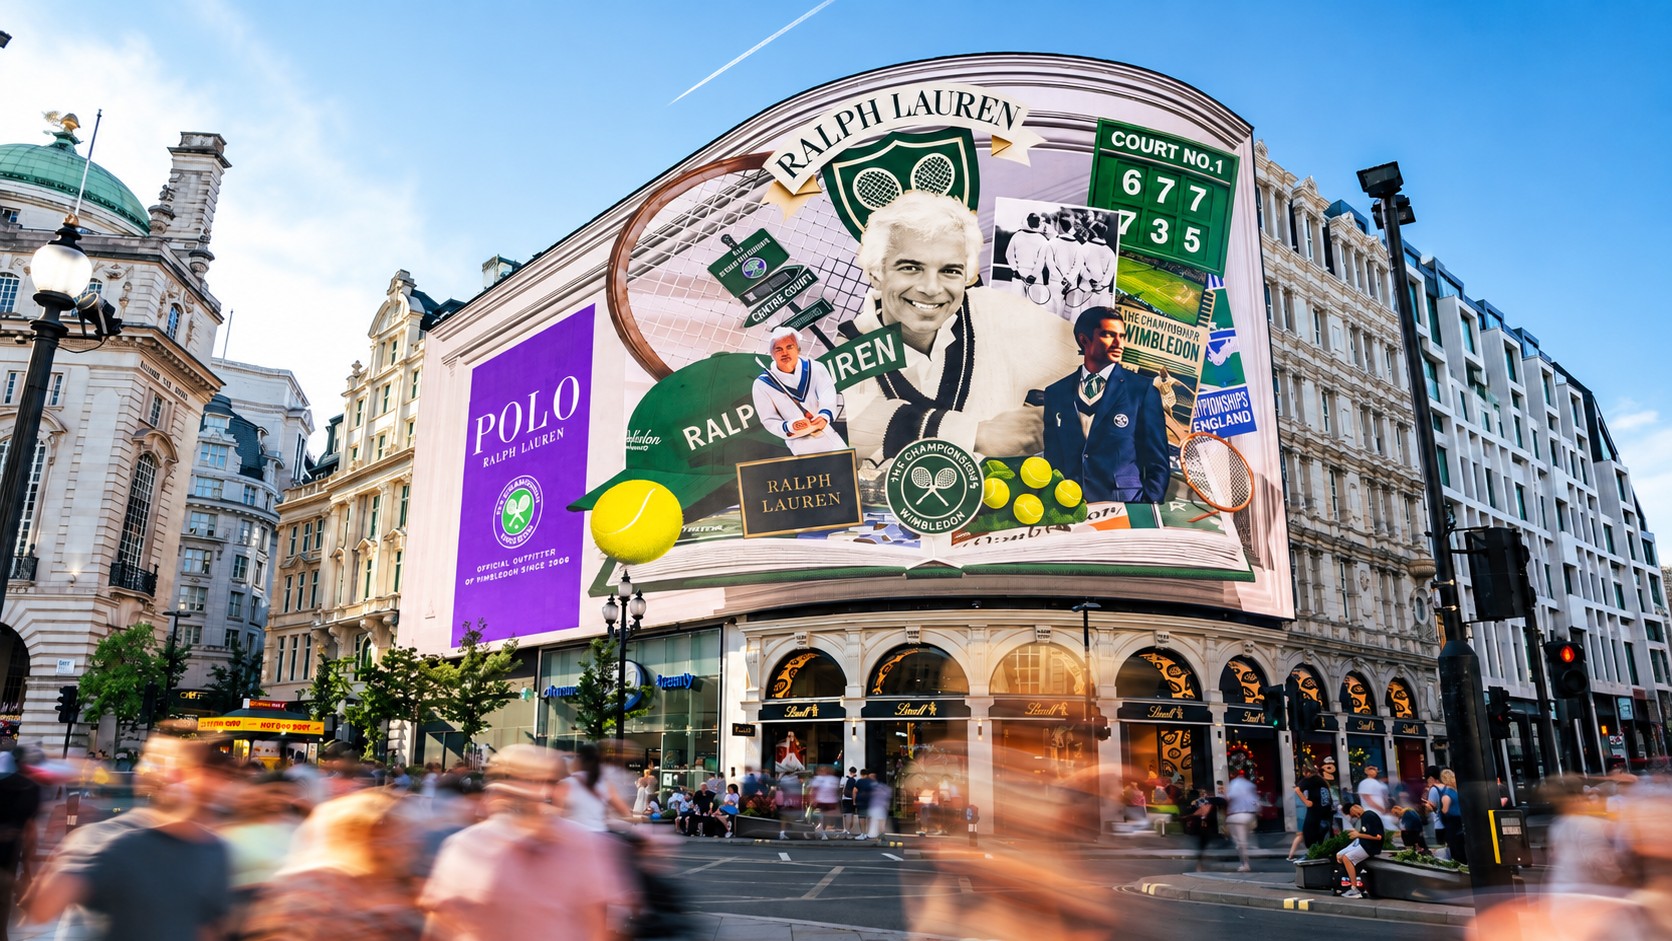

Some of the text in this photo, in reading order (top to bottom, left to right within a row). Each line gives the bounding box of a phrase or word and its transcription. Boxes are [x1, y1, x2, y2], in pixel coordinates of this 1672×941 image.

[775, 90, 1021, 180] RALPH LAUREN
[1111, 131, 1223, 174] COURT NO.1
[1122, 169, 1207, 212] 6 7 7
[1118, 209, 1201, 253] 7 3 5
[1125, 323, 1200, 362] WIMBLEDON
[472, 375, 580, 456] POLO
[1193, 410, 1252, 433] ENGLAND
[483, 427, 564, 468] RALPH LAUREN
[761, 491, 841, 513] LAUREN
[767, 473, 832, 493] RALPH
[899, 507, 966, 531] WIMBLEDON
